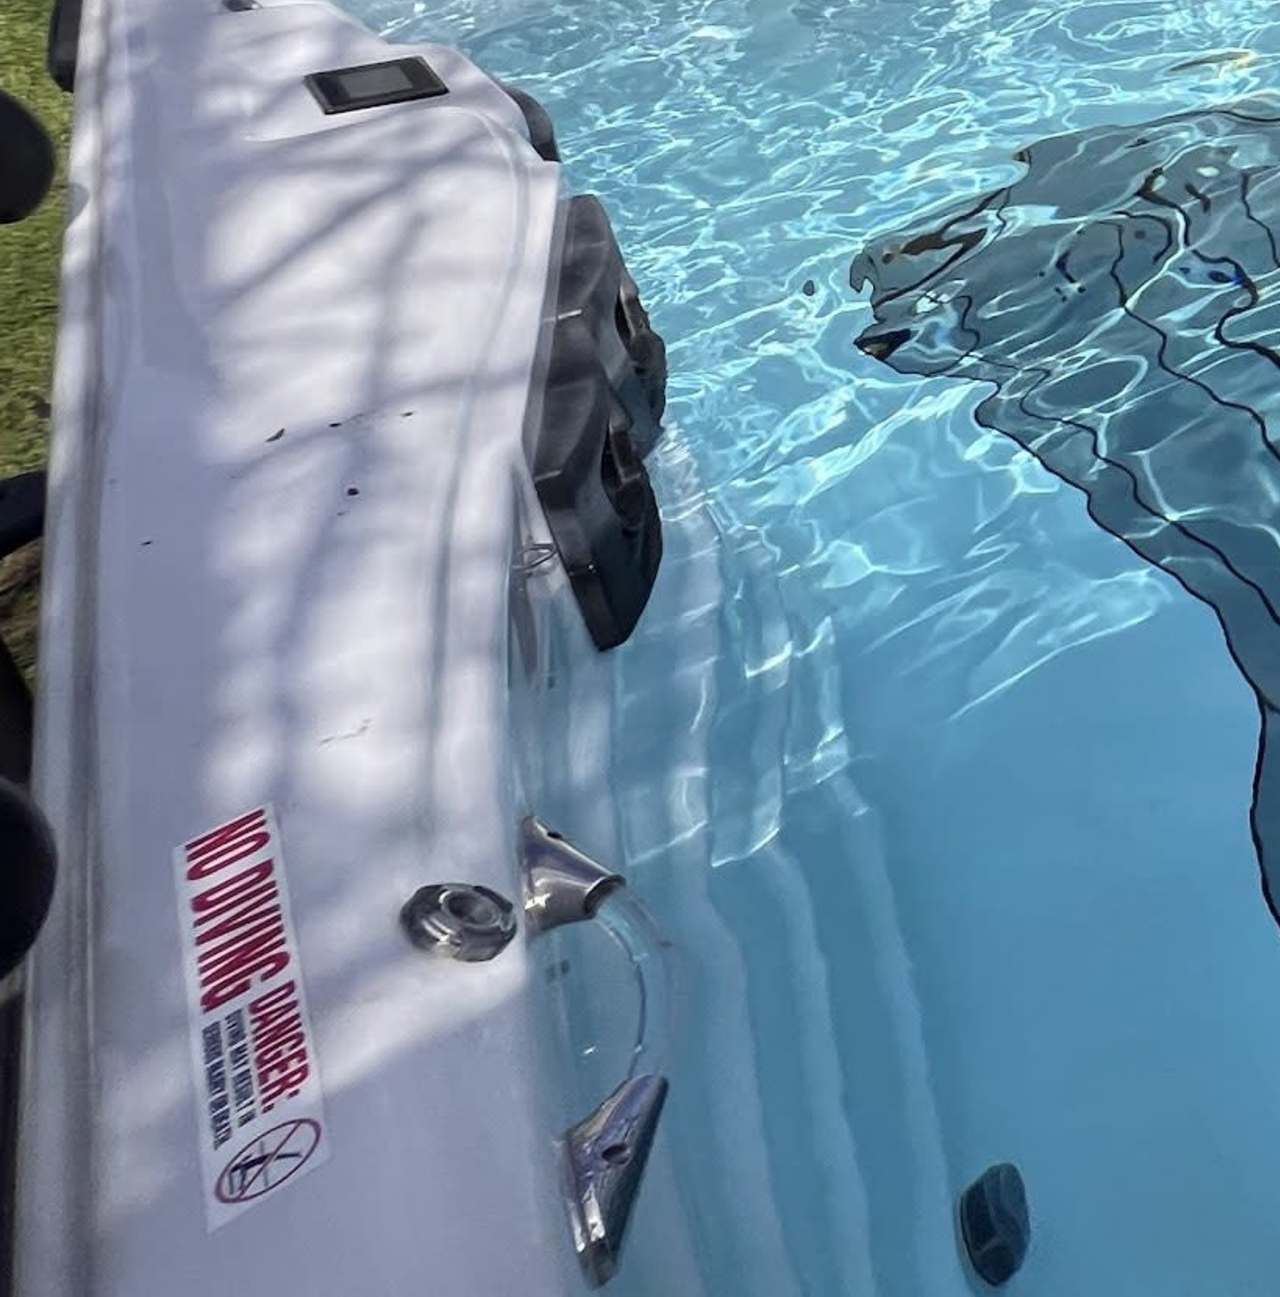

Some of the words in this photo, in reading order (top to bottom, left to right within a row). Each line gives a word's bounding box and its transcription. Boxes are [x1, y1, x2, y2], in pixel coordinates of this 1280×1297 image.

[184, 808, 271, 881] NO
[190, 858, 291, 1014] DIVING
[247, 979, 308, 1114] DANGER:
